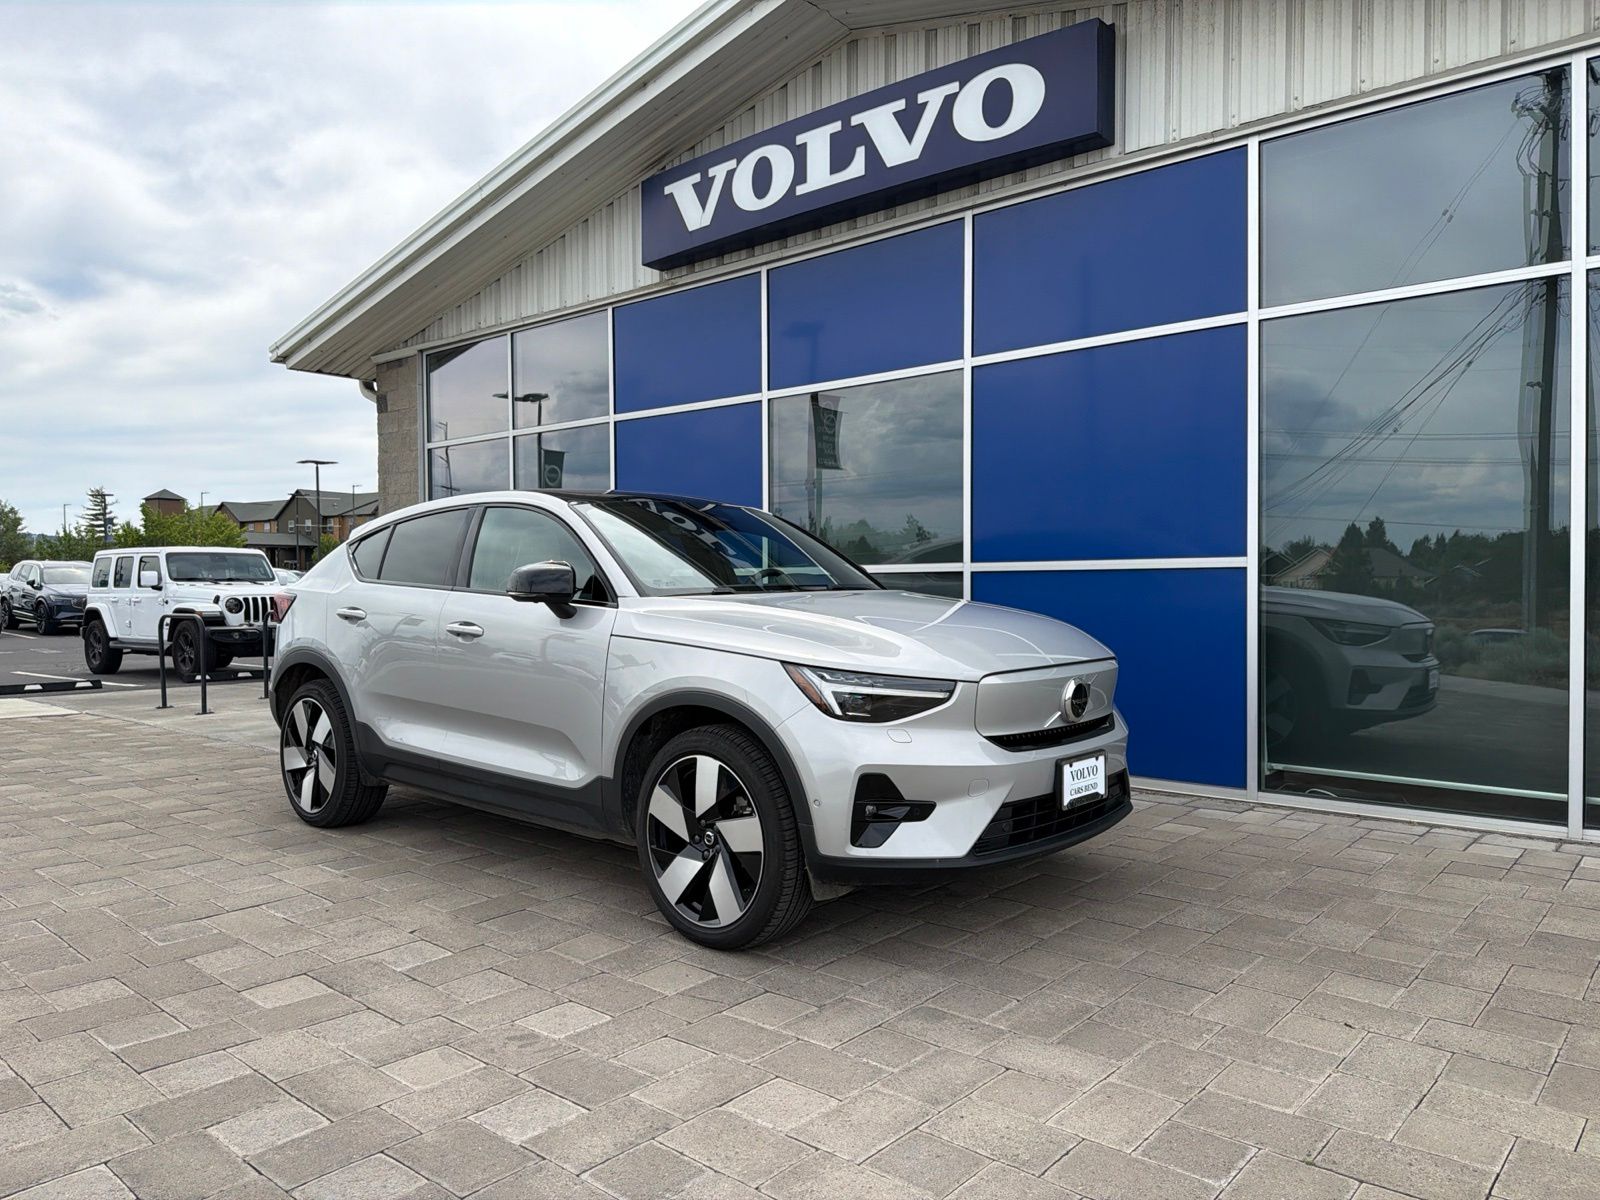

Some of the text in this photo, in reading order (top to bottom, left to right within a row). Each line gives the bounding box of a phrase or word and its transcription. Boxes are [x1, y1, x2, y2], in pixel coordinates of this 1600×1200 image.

[664, 62, 1046, 232] VOLVO
[1070, 764, 1098, 781] VOLVO
[1070, 782, 1098, 796] CARS BEND
